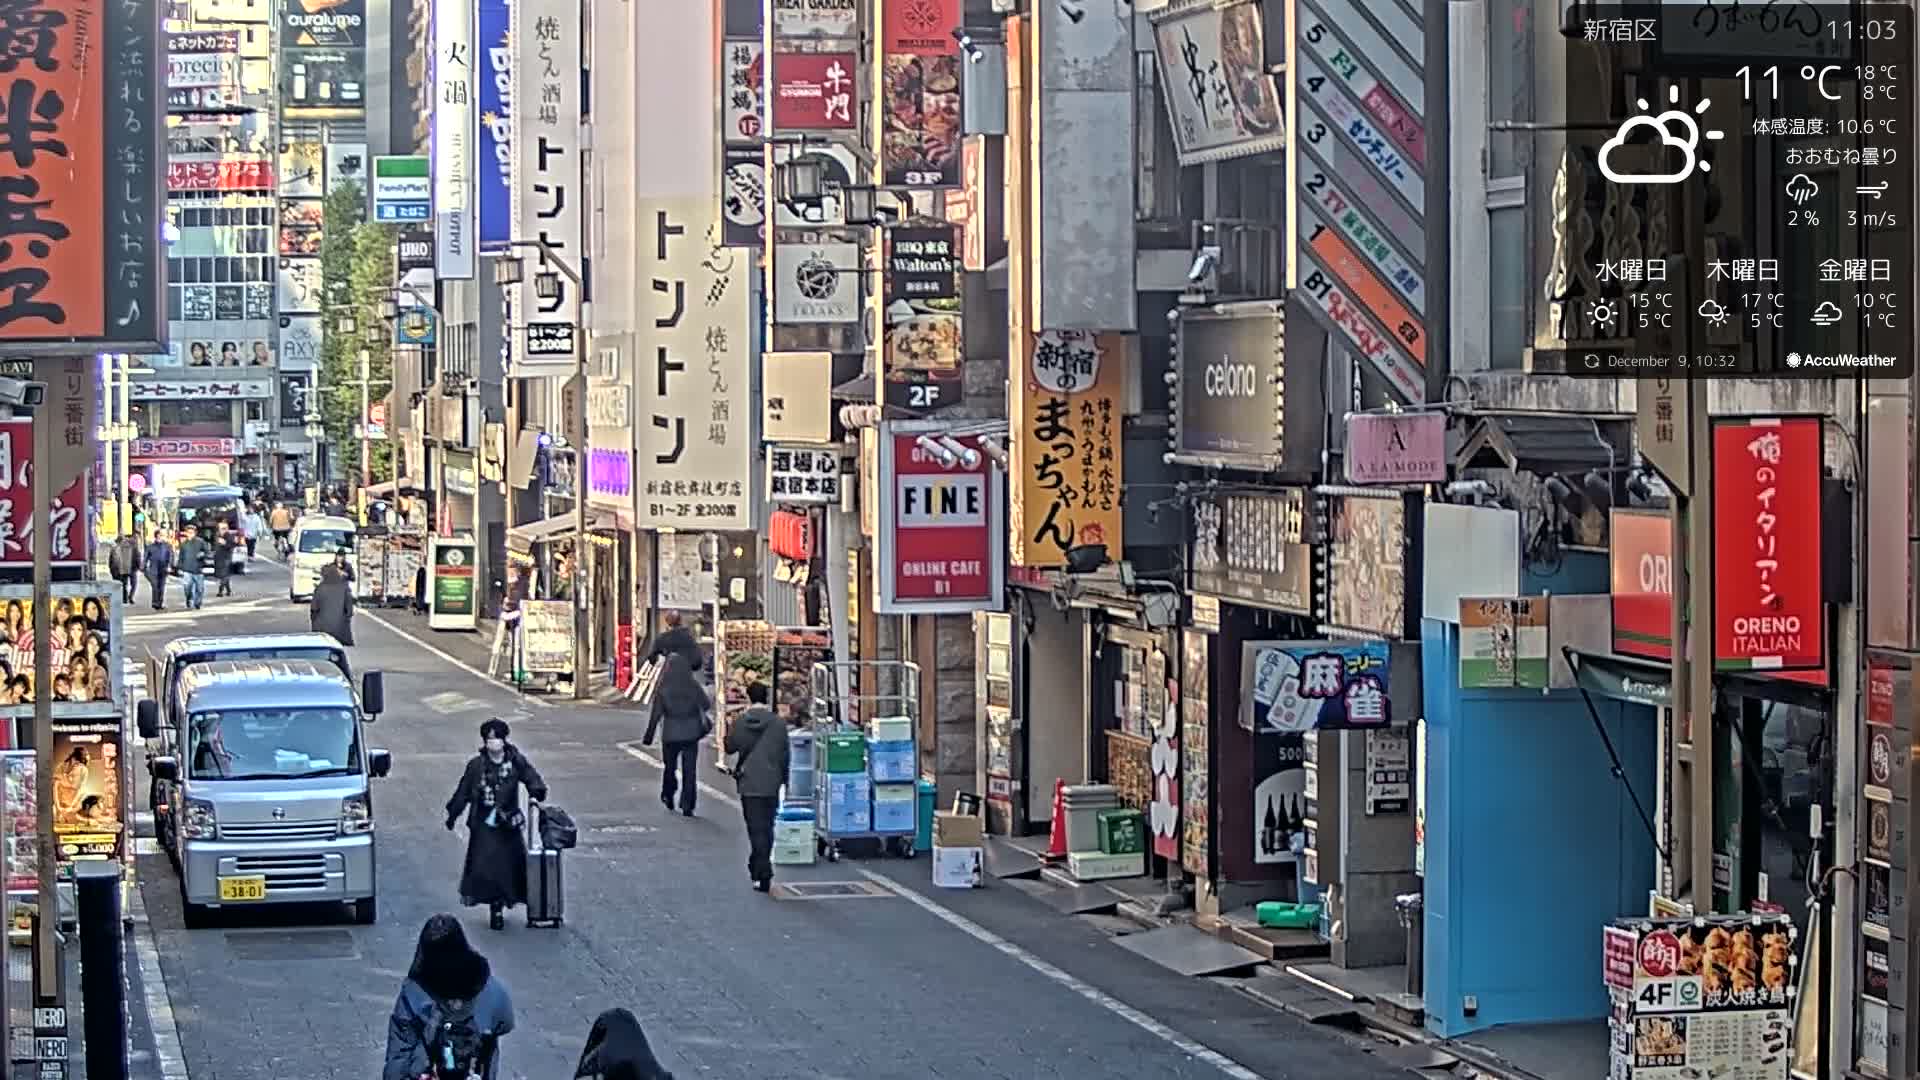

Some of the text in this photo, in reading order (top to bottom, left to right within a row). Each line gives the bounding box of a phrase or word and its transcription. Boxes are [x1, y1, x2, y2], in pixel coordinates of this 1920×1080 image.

[288, 11, 361, 27] auralume
[1307, 24, 1327, 43] 5
[824, 60, 851, 121] 牛門
[1307, 76, 1326, 93] 4
[1307, 123, 1326, 143] 3
[905, 171, 942, 184] 3F
[1305, 174, 1326, 195] 2
[378, 183, 428, 193] FamilyMart
[1309, 224, 1326, 241] 1
[893, 257, 952, 273] Walton's
[1304, 271, 1332, 300] B1
[652, 211, 685, 464] トントン
[910, 386, 939, 406] 2F
[1388, 423, 1407, 452] A
[772, 452, 836, 473] 酒場心
[1033, 397, 1078, 550] まっちゃん
[772, 476, 836, 495] 新宿本店
[904, 486, 979, 514] FINE
[1747, 431, 1781, 604] 俺のイタリアン
[903, 560, 980, 577] ONLINE CAFE
[1734, 616, 1800, 634] ORENO
[1733, 634, 1800, 652] ITALIAN
[1639, 982, 1673, 1006] 4F
[35, 1008, 65, 1028] NERO
[37, 1039, 67, 1058] NERO
